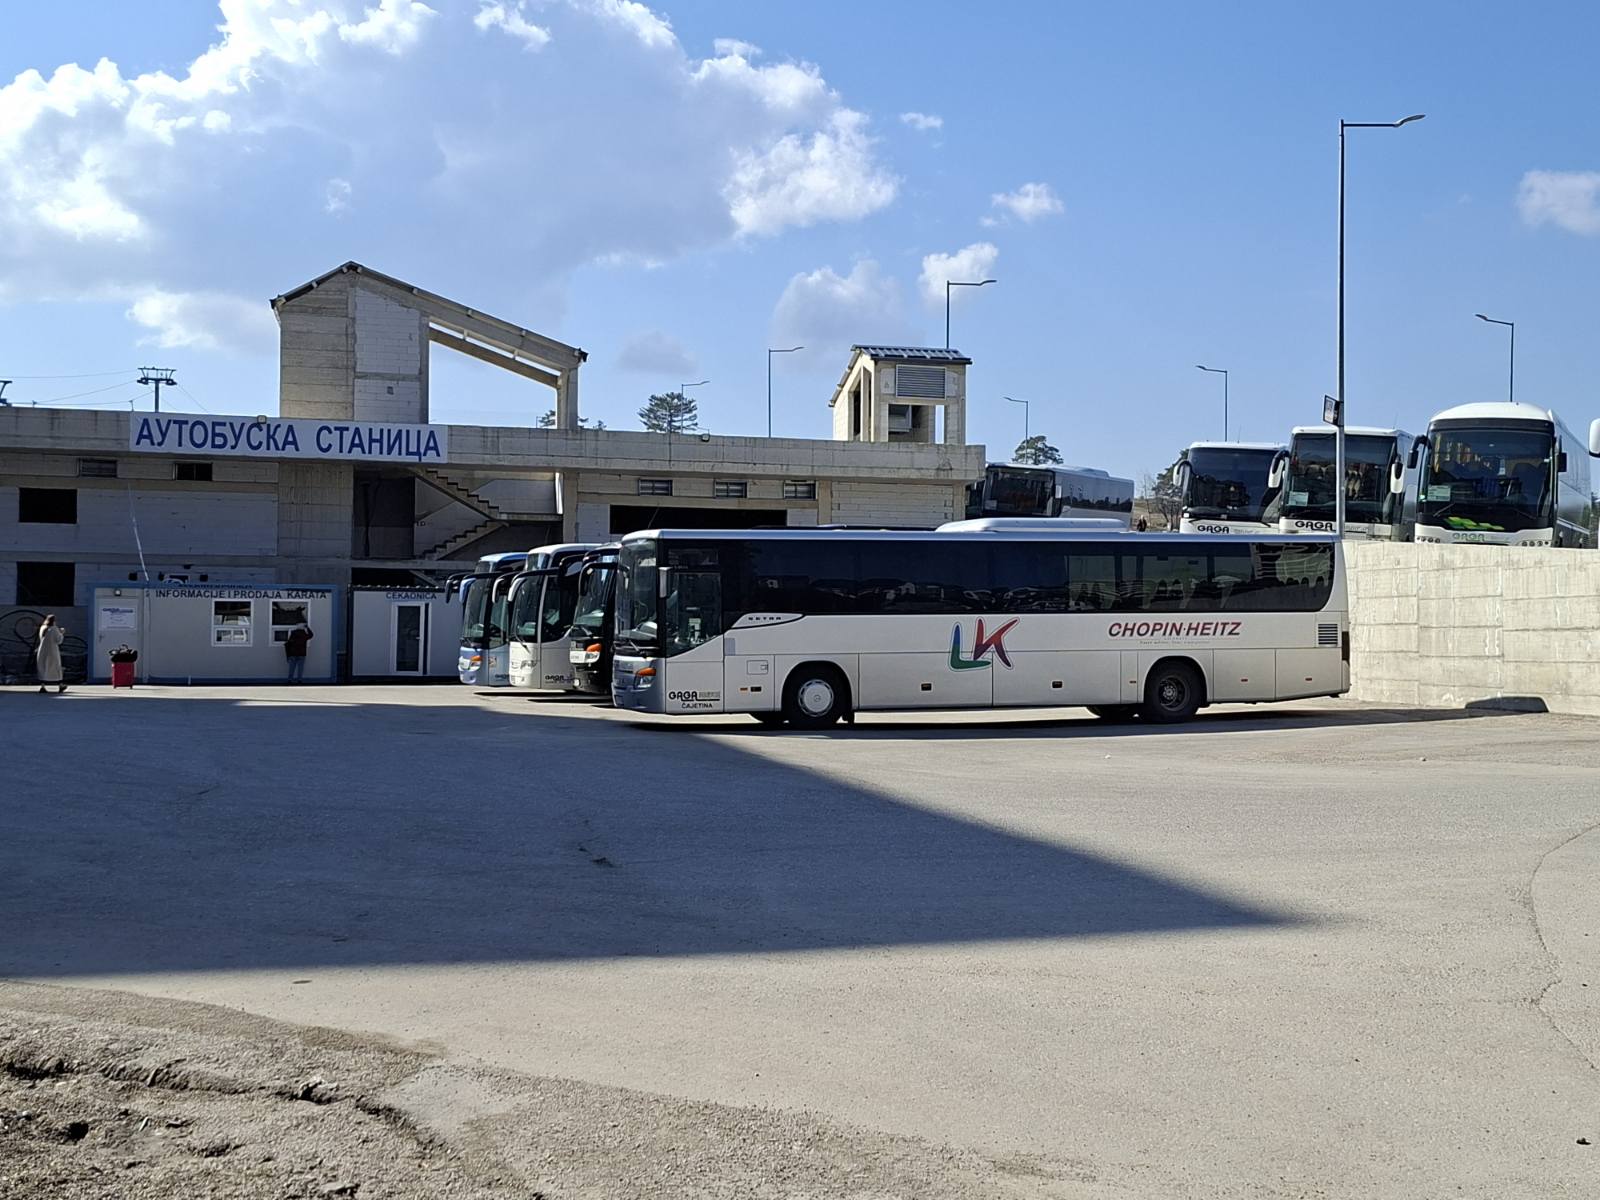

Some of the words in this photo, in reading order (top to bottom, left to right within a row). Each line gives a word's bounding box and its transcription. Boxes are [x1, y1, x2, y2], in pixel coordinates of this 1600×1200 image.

[135, 417, 300, 452] АУТОБУСКА
[315, 424, 441, 462] СТАНИЦА
[1294, 520, 1333, 532] GAGA
[155, 589, 226, 600] INFORMACIJE
[234, 590, 282, 600] PRODAJA
[287, 590, 327, 600] KARATA
[668, 691, 698, 701] GAGA
